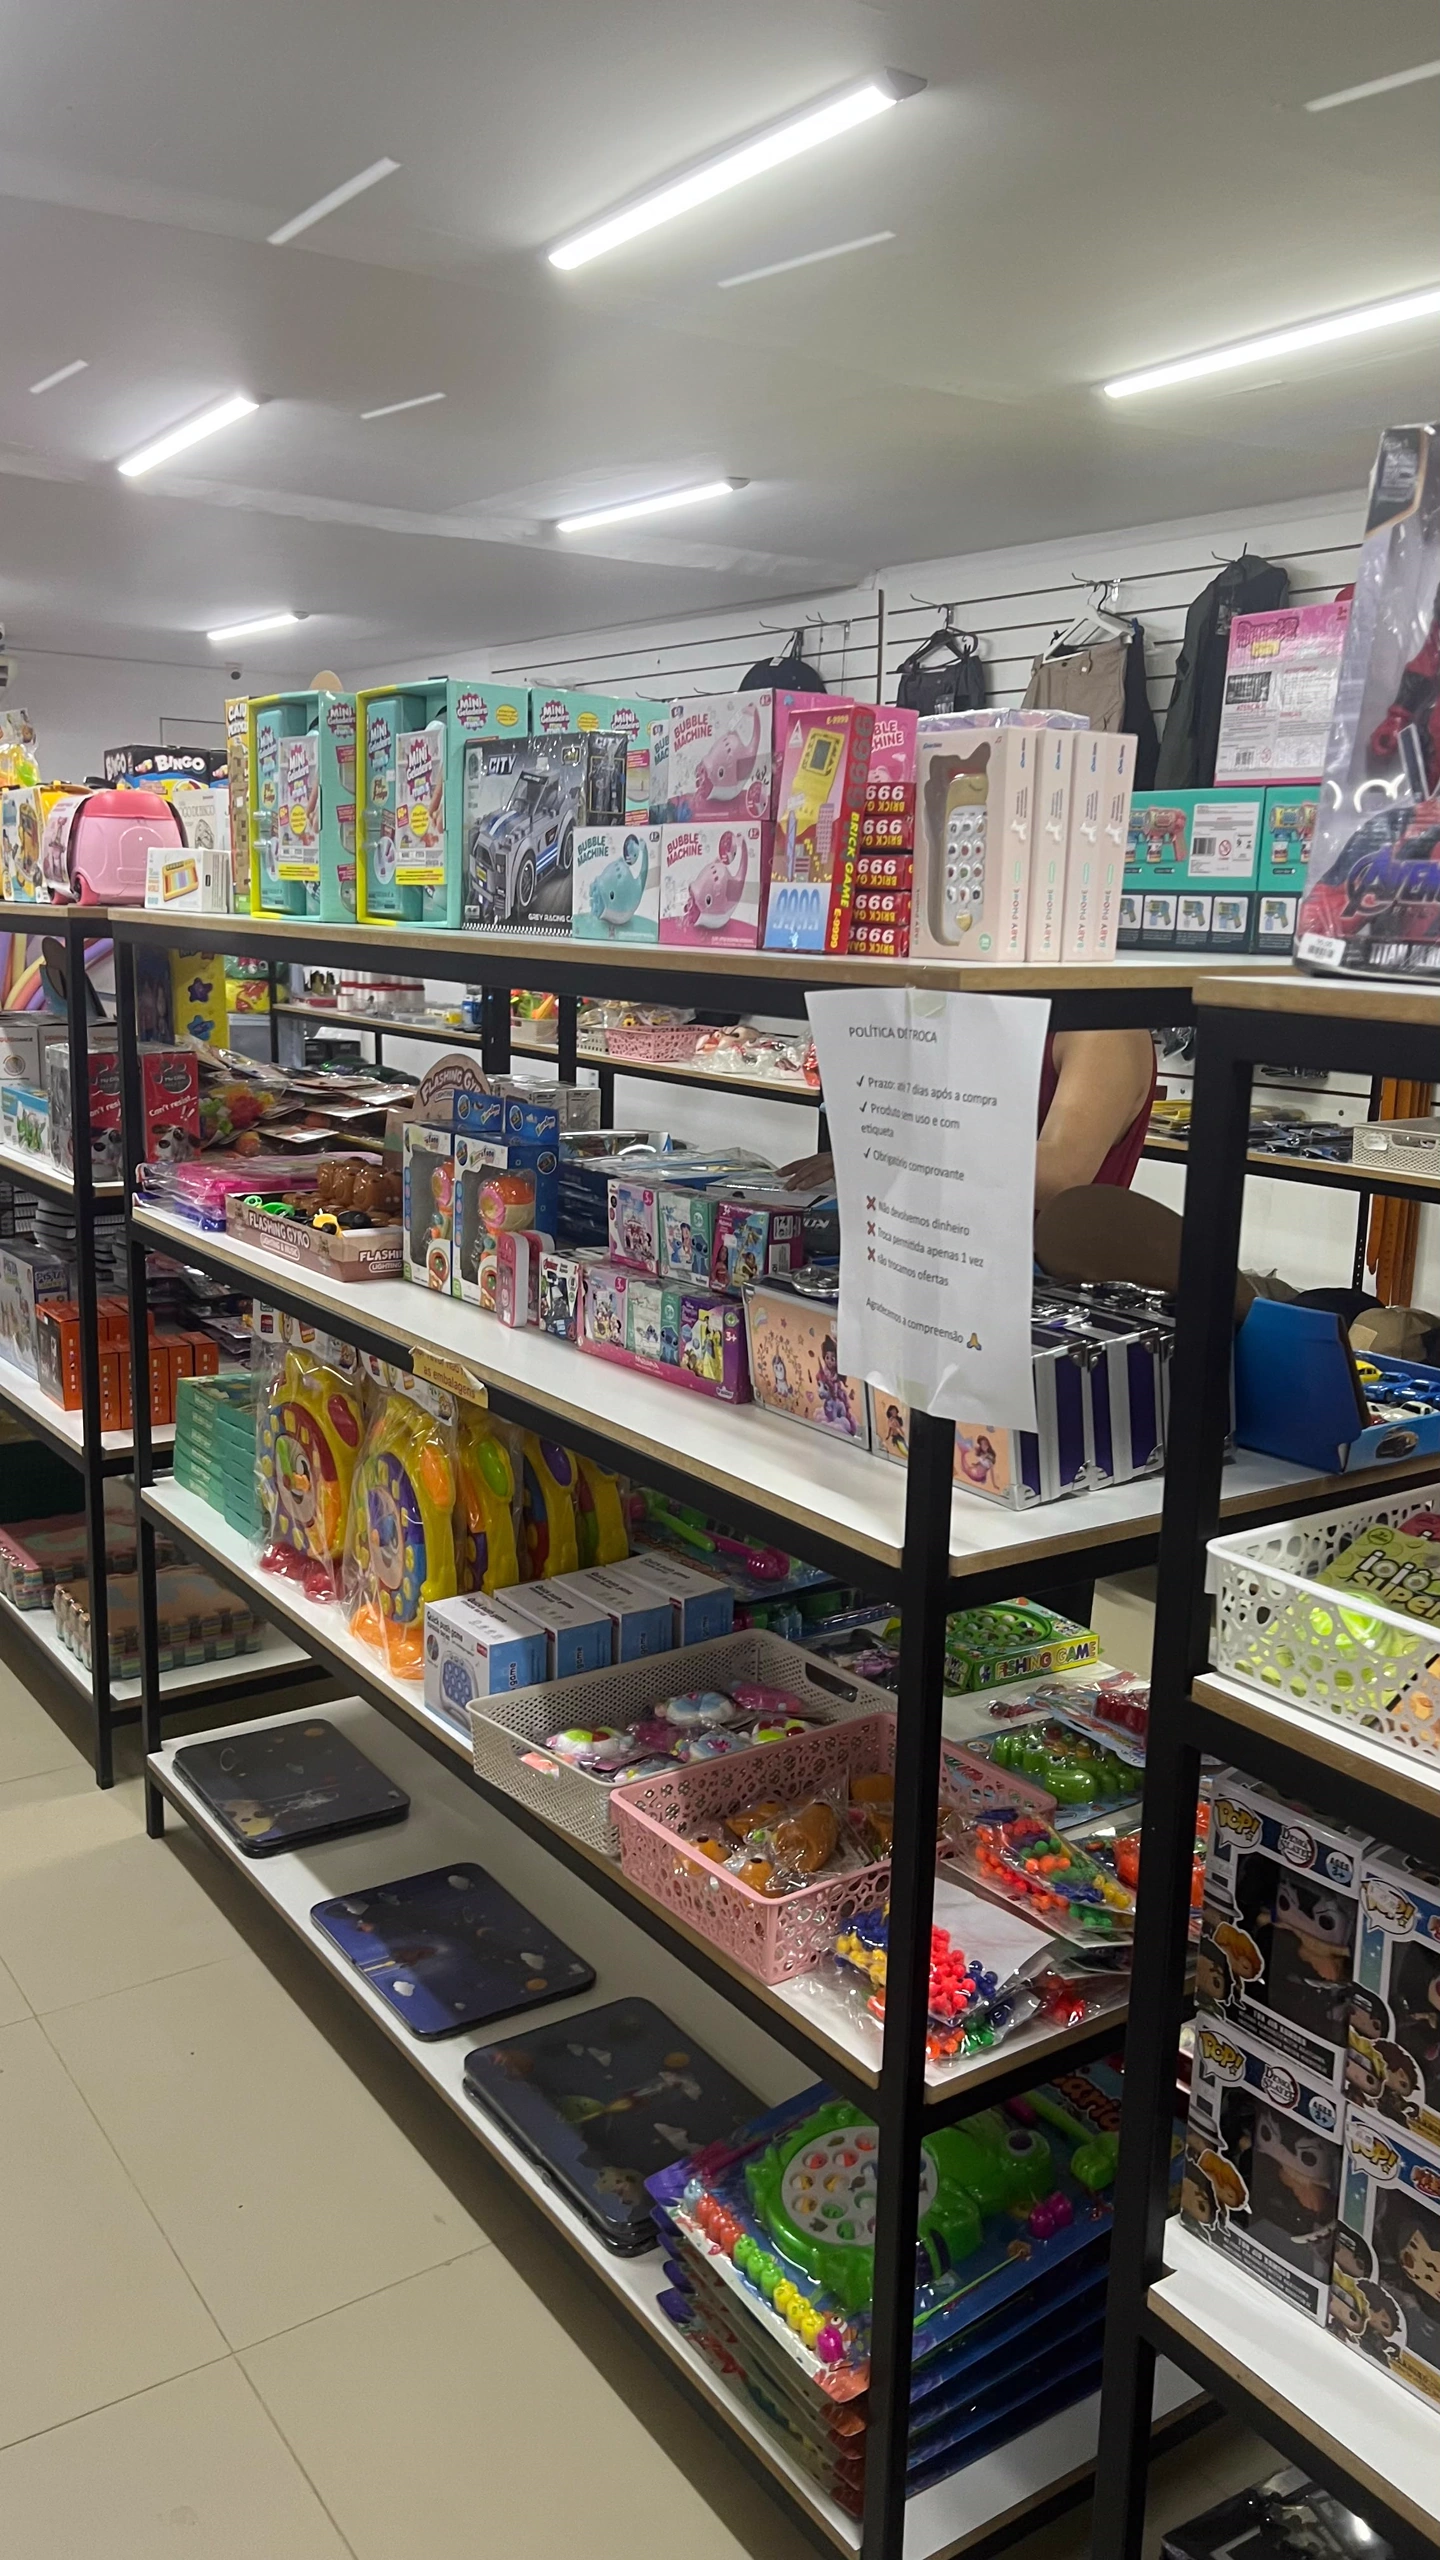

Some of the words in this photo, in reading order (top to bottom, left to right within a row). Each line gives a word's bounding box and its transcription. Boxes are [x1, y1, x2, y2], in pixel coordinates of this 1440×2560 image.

[673, 713, 709, 739] BUBBLE
[873, 721, 898, 736] BLE
[594, 736, 624, 749] CITY
[654, 735, 669, 754] BUB
[673, 724, 713, 752] MACHINE
[872, 732, 904, 752] HINE
[154, 754, 206, 773] BINGO
[488, 755, 517, 774] CITY
[654, 747, 669, 766] MAC
[577, 835, 607, 854] BUBBLE
[666, 833, 700, 854] BUBBLE
[847, 811, 860, 859] BRICK
[577, 847, 609, 867] MACHINE
[666, 844, 703, 868] MACHINE
[840, 861, 855, 909] GAME
[527, 912, 543, 921] GREY
[543, 913, 566, 923] RACING
[1010, 923, 1019, 949] BABY
[1077, 923, 1086, 949] BABY
[1100, 924, 1109, 949] BABY
[848, 1024, 896, 1039] POLÍTICA
[908, 1029, 938, 1043] TROCA
[420, 1065, 465, 1106] FLASHING
[868, 1076, 896, 1090] Prazo:
[912, 1083, 929, 1097] dias
[931, 1085, 953, 1101] após
[954, 1091, 960, 1101] a
[962, 1092, 998, 1107] compra
[90, 1106, 105, 1118] an't
[106, 1100, 121, 1112] resi
[149, 1102, 170, 1117] Can't
[860, 1122, 895, 1138] etiqueta
[915, 1113, 931, 1125] uso
[932, 1116, 939, 1127] e
[939, 1117, 961, 1130] com
[908, 1161, 965, 1182] comprovante
[248, 1209, 287, 1240] FLASHING
[287, 1227, 311, 1249] GYRO
[932, 1217, 970, 1236] dinheiro
[359, 1249, 403, 1263] FLASHI
[926, 1245, 960, 1262] apenas
[969, 1255, 984, 1268] vez
[917, 1269, 949, 1287] ofertas
[725, 1331, 737, 1342] 3+
[907, 1318, 965, 1344] compreensão
[423, 1366, 432, 1377] as
[432, 1370, 476, 1399] embalagens
[426, 1611, 439, 1626] Quick
[439, 1620, 451, 1633] push
[450, 1627, 464, 1643] game
[994, 1651, 1053, 1681] FISHING
[1056, 1641, 1097, 1666] GAME
[510, 1661, 518, 1686] game
[1214, 1799, 1263, 1836] POP!
[1279, 1840, 1313, 1862] SLAYER
[1329, 1856, 1350, 1871] AGES
[1199, 2029, 1244, 2070] POP!
[1263, 2078, 1296, 2100] SLAYER
[1312, 2100, 1333, 2118] AGES
